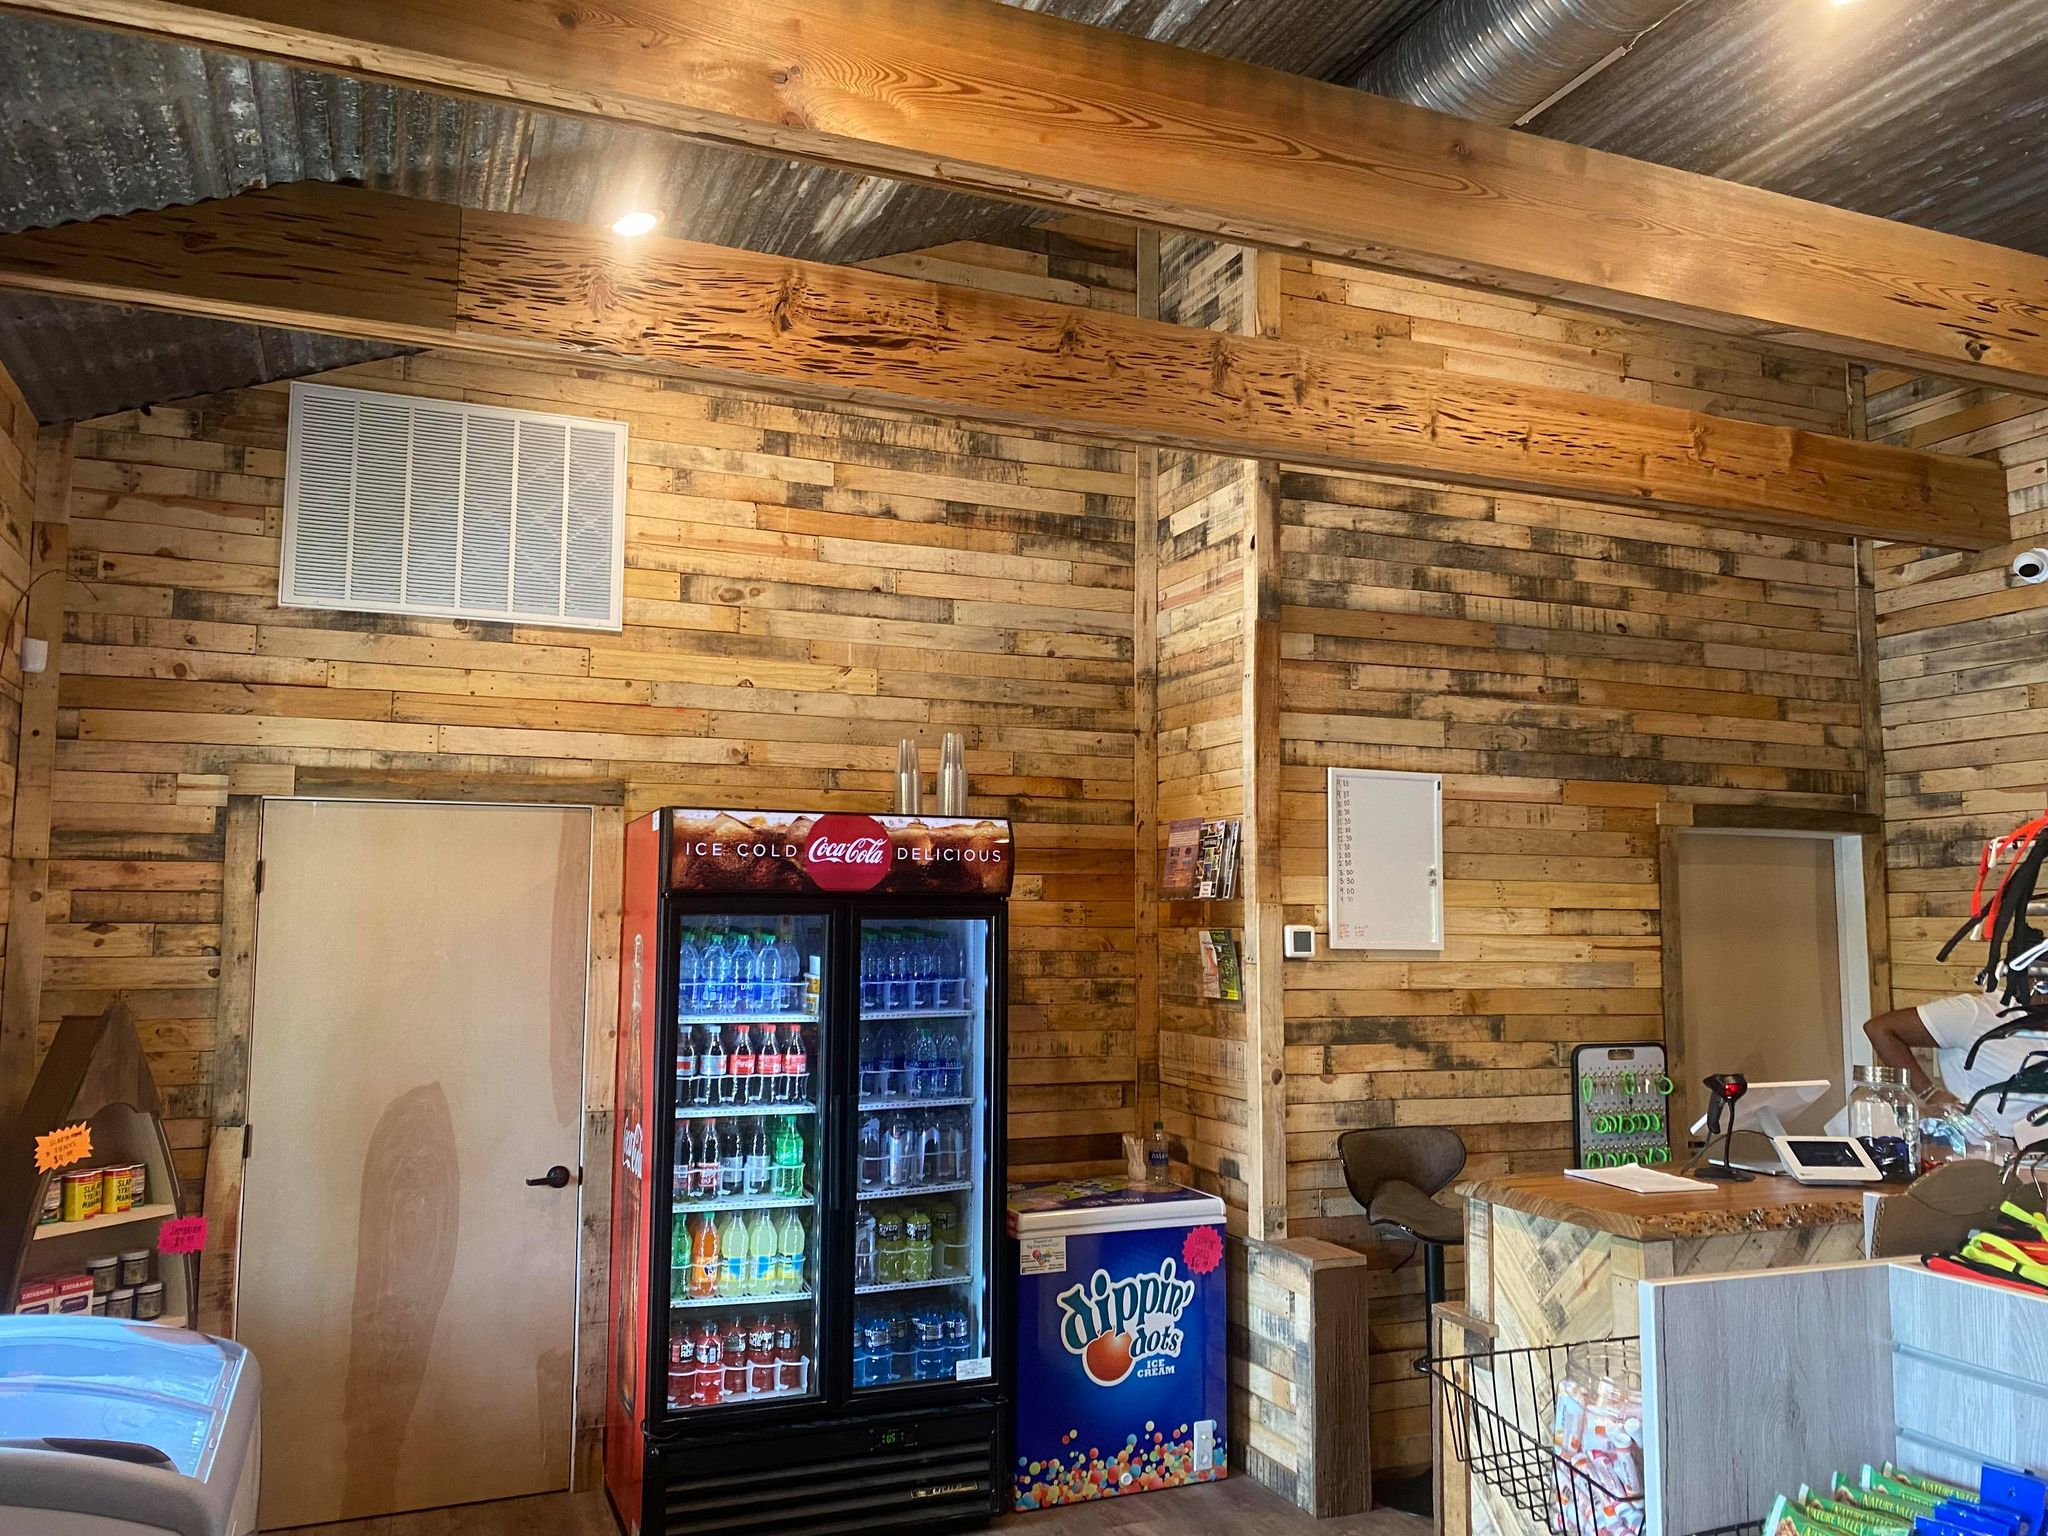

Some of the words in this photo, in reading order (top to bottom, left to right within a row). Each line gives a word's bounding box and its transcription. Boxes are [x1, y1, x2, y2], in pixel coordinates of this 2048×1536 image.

[685, 842, 723, 857] ICE
[736, 843, 798, 858] COLD
[808, 836, 889, 864] Coca-Cola
[897, 847, 1001, 863] DELICIOUS
[1060, 1262, 1192, 1350] dippin'
[1130, 1325, 1180, 1358] dots
[1136, 1365, 1176, 1378] CREAM
[1146, 1358, 1165, 1368] ICE
[1862, 1494, 1895, 1513] NATURE
[1955, 1490, 1980, 1505] VALLE
[1805, 1505, 1835, 1525] NATURE
[1837, 1516, 1864, 1536] VALLEY
